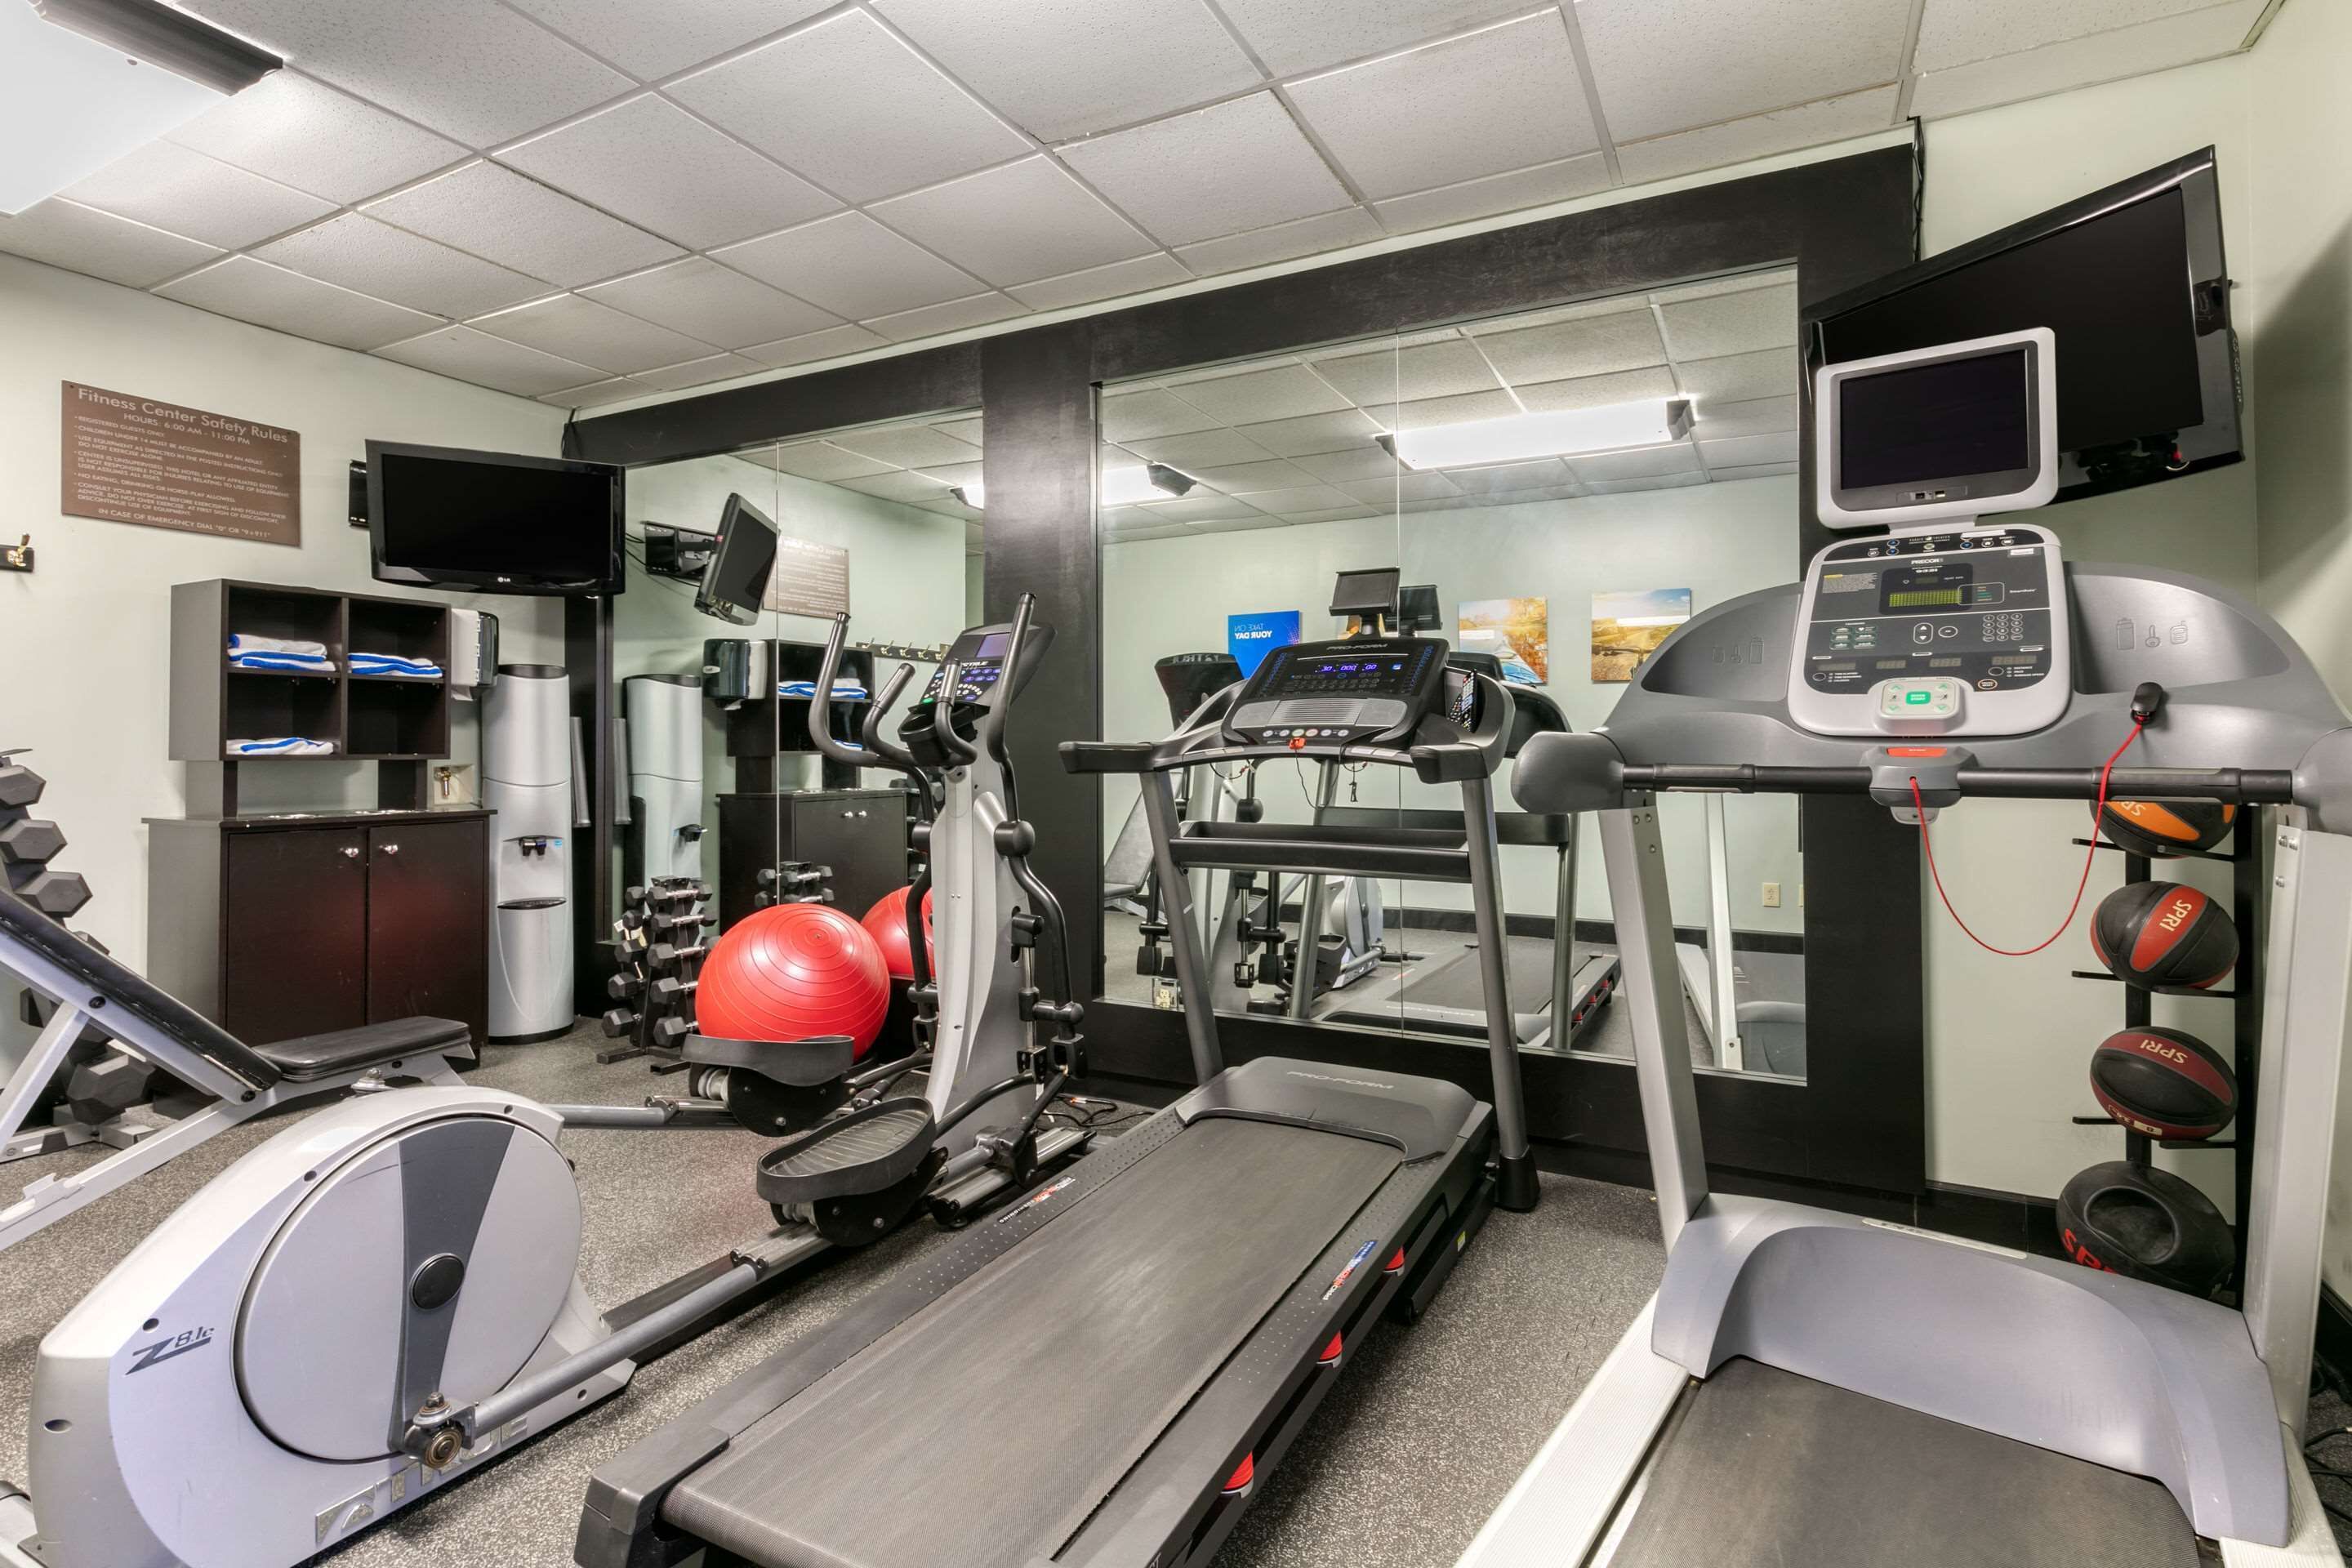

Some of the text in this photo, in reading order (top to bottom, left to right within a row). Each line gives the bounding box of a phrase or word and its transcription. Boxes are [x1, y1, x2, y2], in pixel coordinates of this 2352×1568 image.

[78, 387, 288, 443] Fitness Center Safety Rules
[78, 415, 118, 428] REGISTERED
[119, 423, 145, 433] GUESTS
[77, 424, 113, 436] CHILDREN
[114, 431, 137, 441] UNDER
[177, 444, 223, 457] ACCOMPANIED
[163, 421, 184, 431] 6:00
[186, 426, 202, 435] AM
[211, 431, 235, 442] 11:00
[237, 436, 249, 445] PM
[77, 450, 104, 460] CENTER
[93, 437, 133, 449] EQUIPMENT
[223, 461, 266, 474] INSTRUCTIONS
[109, 446, 138, 456] EXERCISE
[77, 481, 110, 492] CONSULT
[133, 490, 168, 500] PHYSICIAN
[169, 496, 192, 504] BEFORE
[77, 494, 126, 506] DISCONTINUE
[110, 509, 131, 518] CASE
[147, 514, 194, 527] EMERGENCY
[2159, 899, 2193, 932] SPRI
[2140, 1039, 2188, 1064] SPRI
[1287, 1071, 1394, 1089] PRO-FORM
